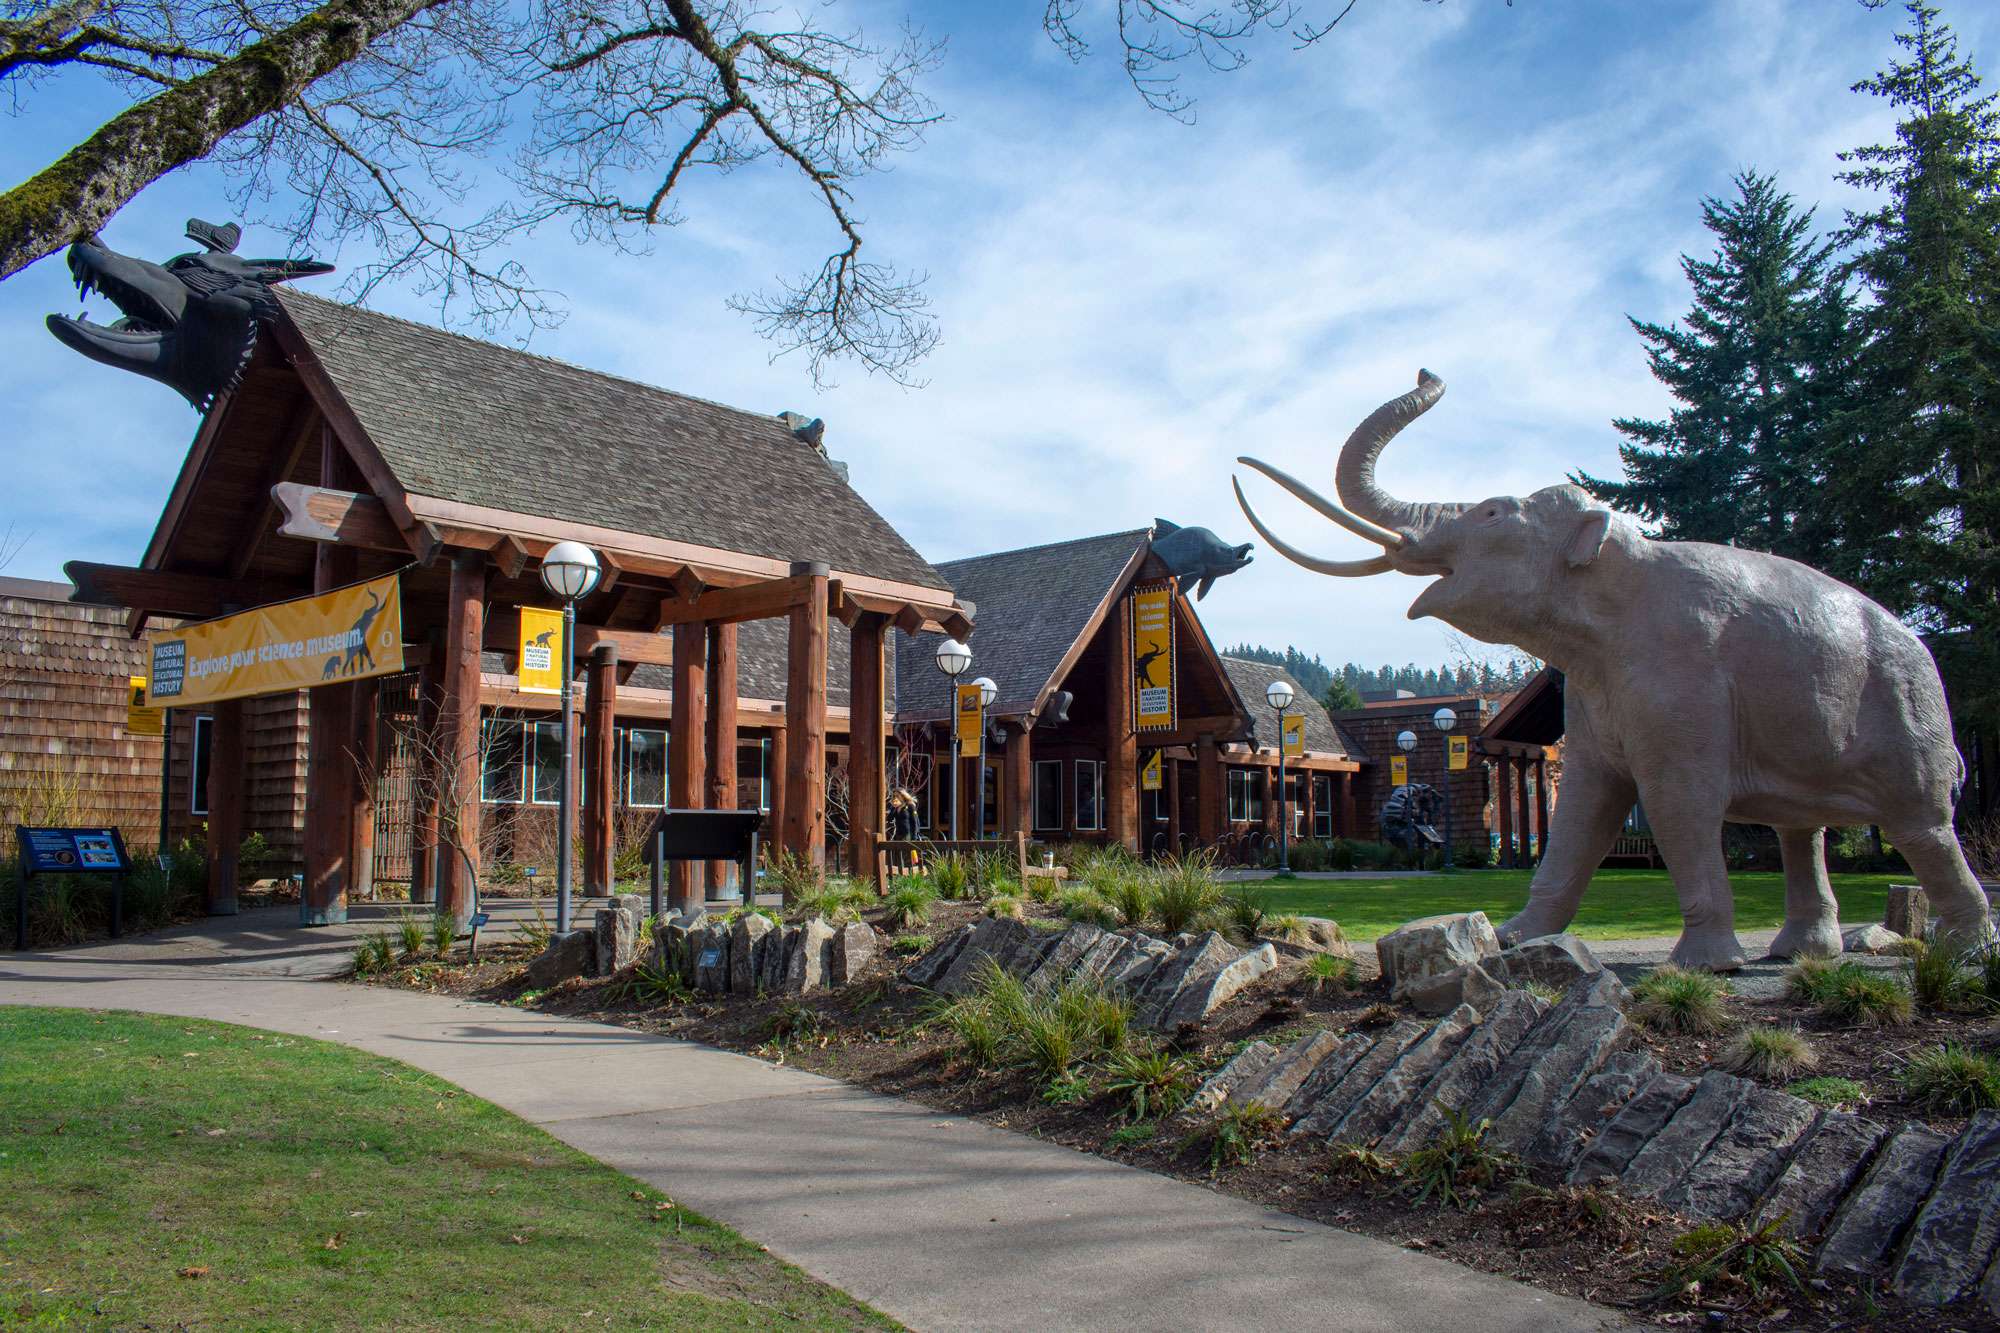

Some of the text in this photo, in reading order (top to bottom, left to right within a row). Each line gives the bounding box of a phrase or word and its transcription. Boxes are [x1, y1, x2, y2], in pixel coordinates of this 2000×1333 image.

[154, 644, 185, 658] MUSEUM
[188, 627, 364, 680] Explore your science museum.
[160, 658, 184, 669] NATURAL
[160, 670, 183, 679] CULTURAL
[153, 680, 182, 694] HISTORY
[1141, 689, 1167, 697] MUSEUM
